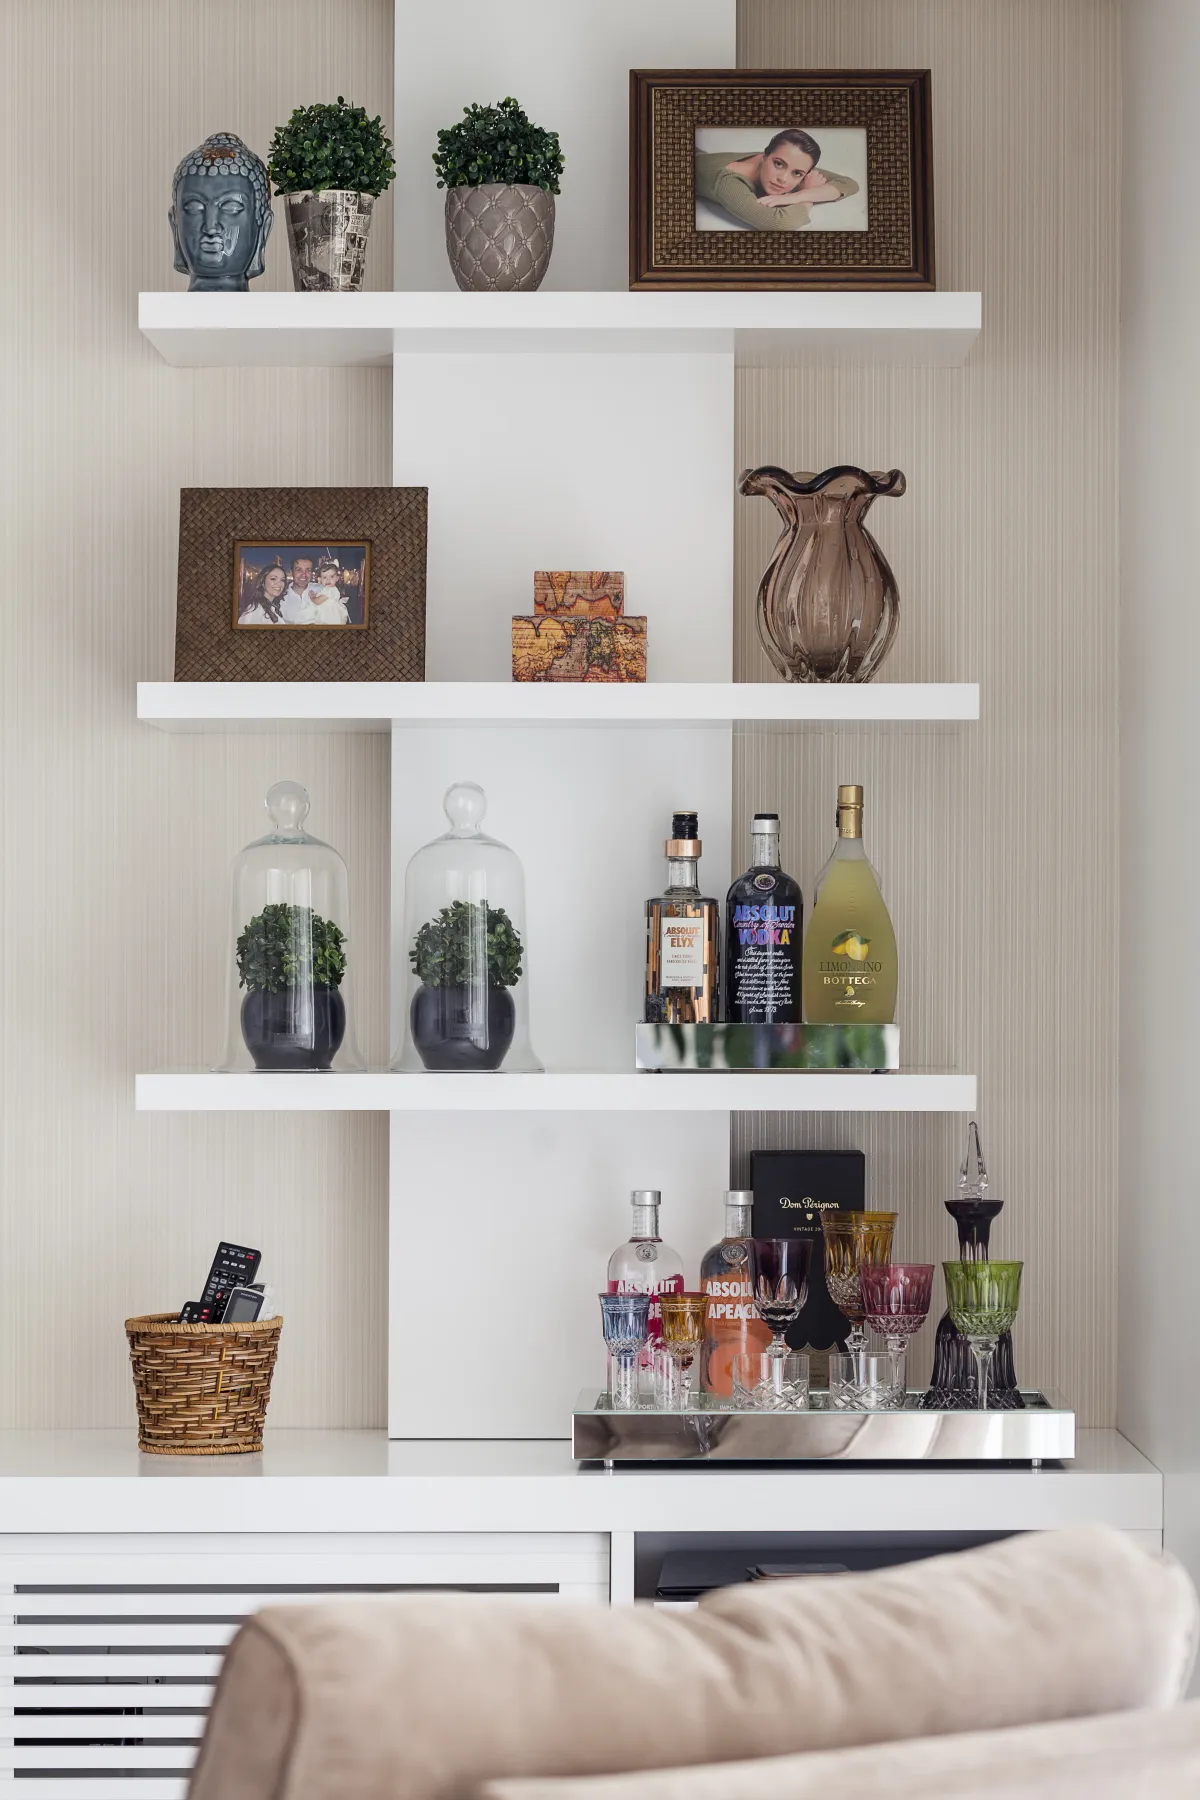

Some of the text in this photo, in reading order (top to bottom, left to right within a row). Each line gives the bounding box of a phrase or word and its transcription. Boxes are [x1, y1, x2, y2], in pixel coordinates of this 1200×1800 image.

[735, 905, 795, 921] ABSOLUT
[666, 926, 699, 935] ABSOLUT
[738, 929, 791, 945] VODKA
[670, 937, 694, 948] ELYX
[819, 961, 883, 972] LIMOINO
[823, 976, 877, 985] BOTTEGA
[779, 1196, 840, 1212] Dom Pérignon
[705, 1281, 754, 1297] ABSOL
